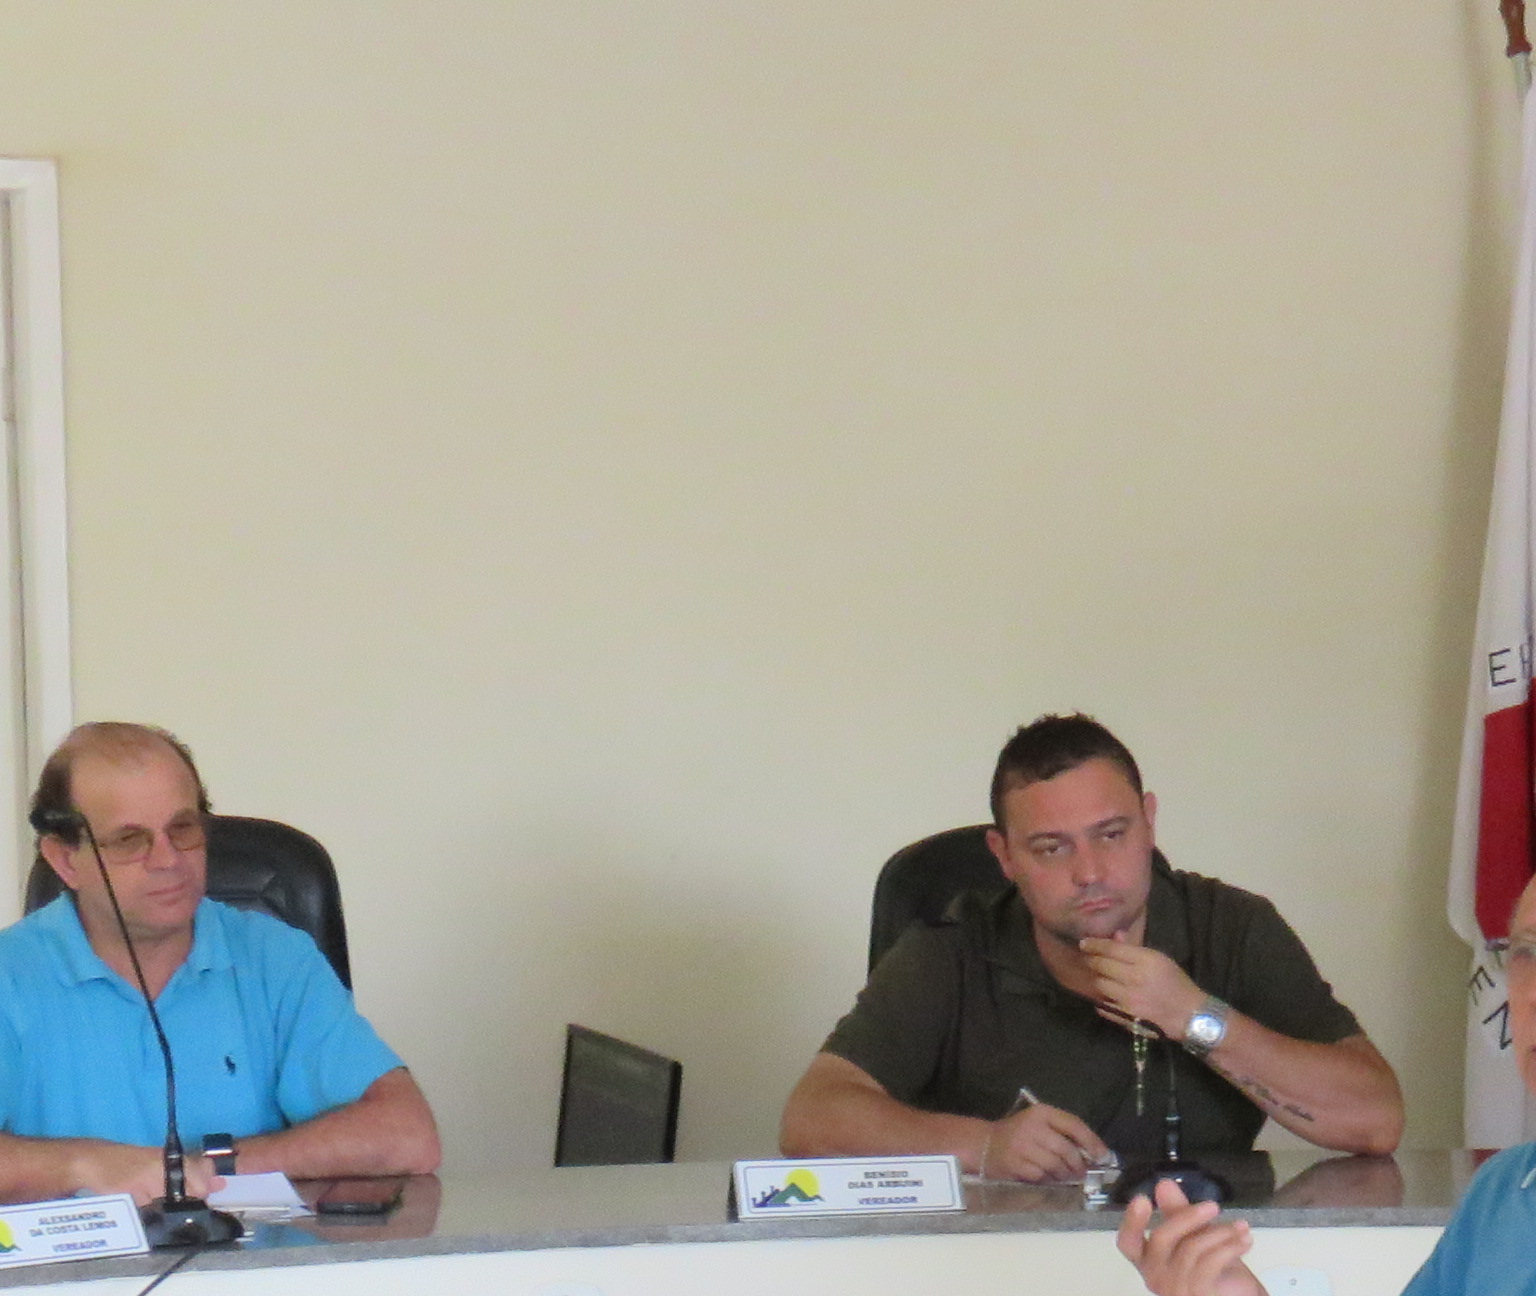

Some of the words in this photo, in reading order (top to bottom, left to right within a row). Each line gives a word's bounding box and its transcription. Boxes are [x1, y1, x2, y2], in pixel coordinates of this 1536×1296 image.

[847, 1180, 874, 1190] DIAS
[857, 1195, 918, 1206] VEREADOR
[38, 1210, 107, 1226] ALEXSANDRO
[29, 1227, 44, 1238] DA
[46, 1223, 80, 1236] COSTA
[82, 1219, 118, 1232] LEMOS
[51, 1238, 108, 1253] VEREADOR
